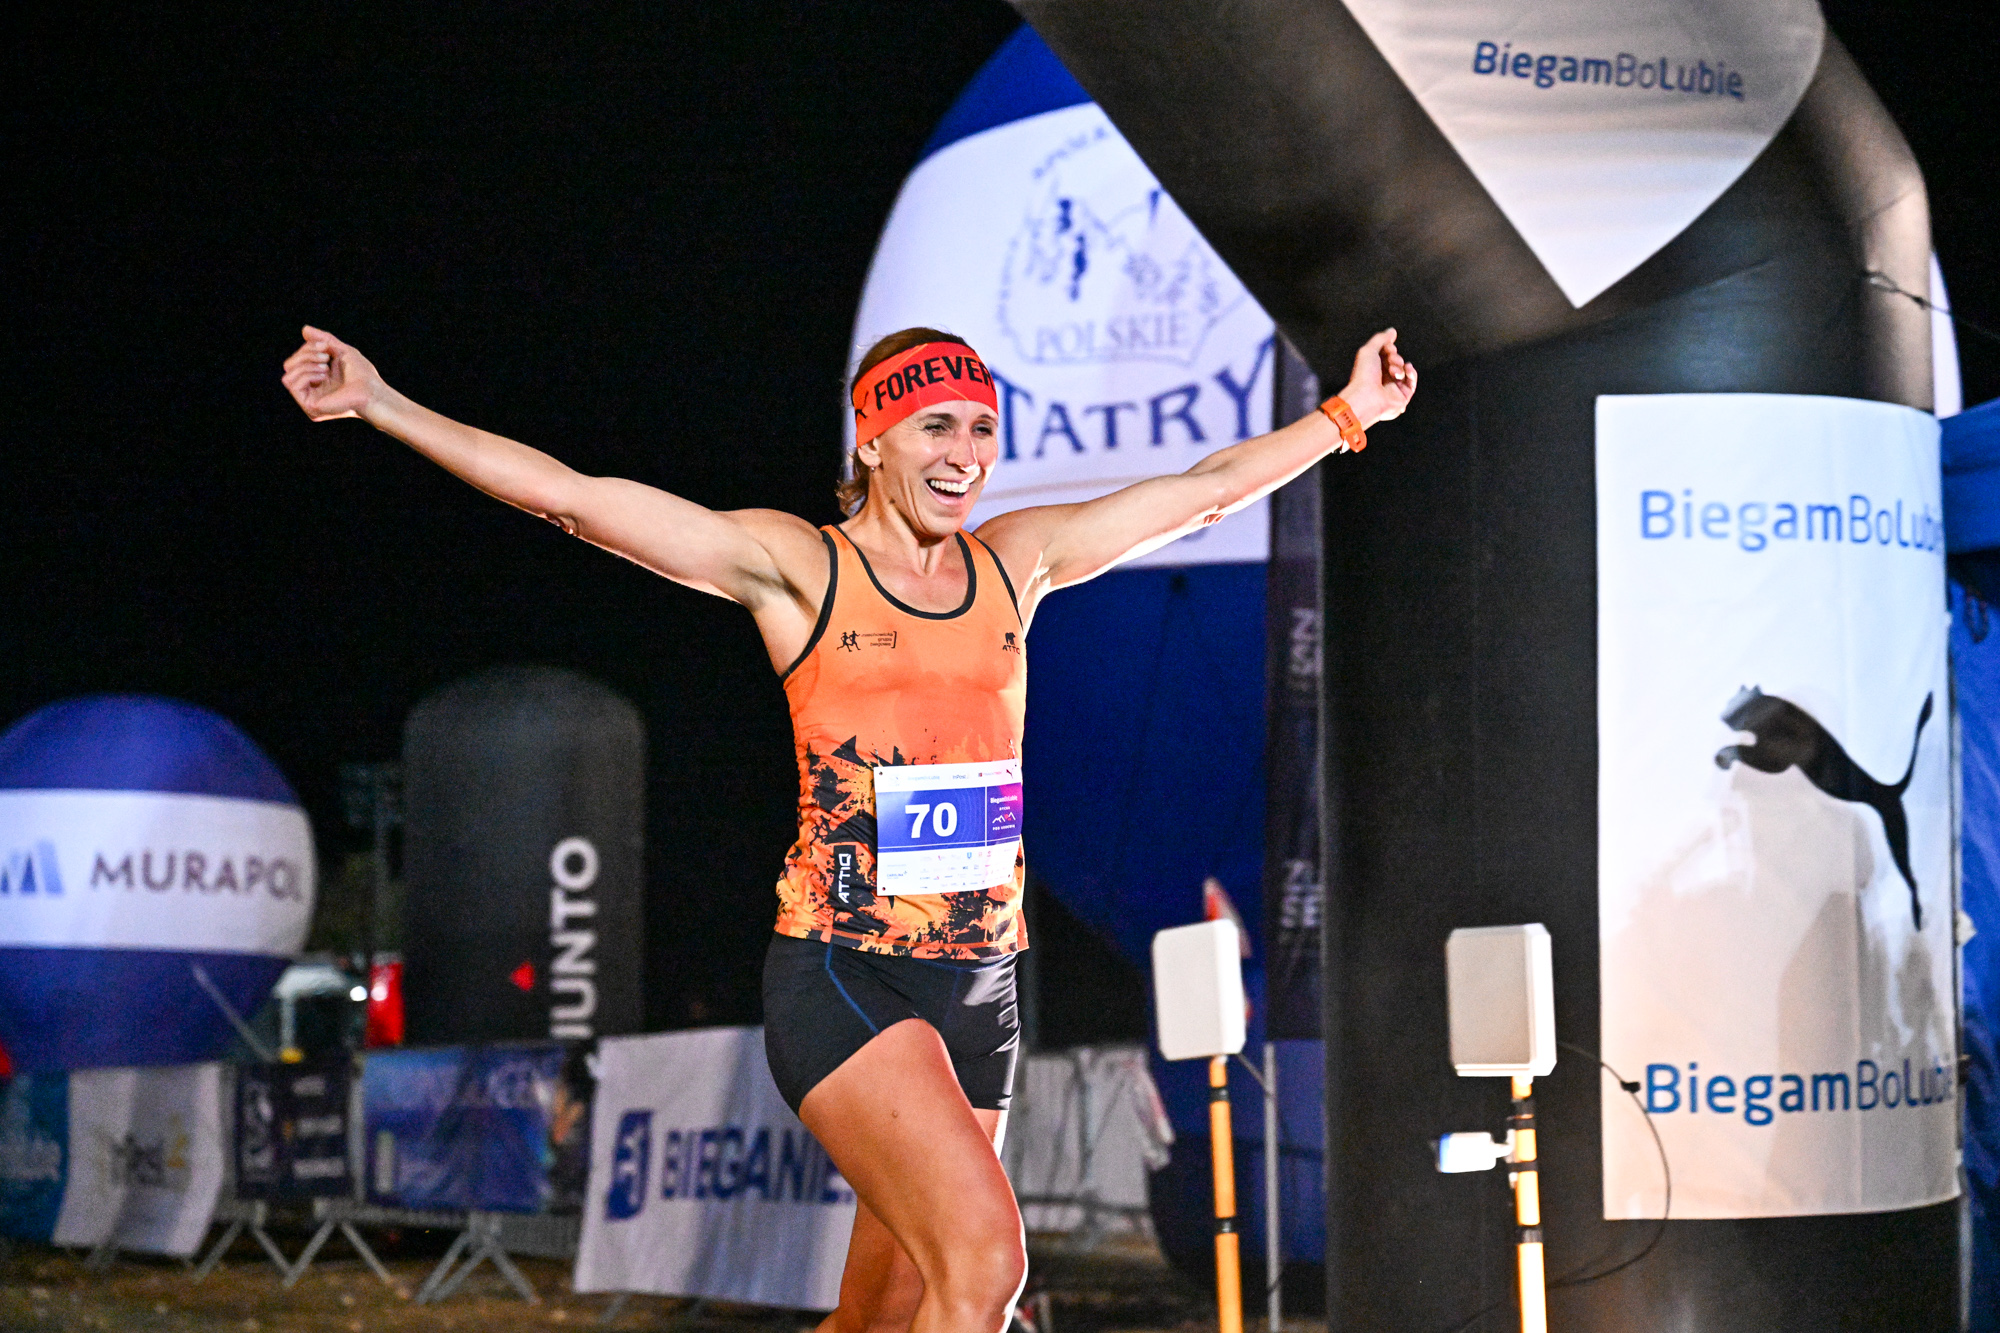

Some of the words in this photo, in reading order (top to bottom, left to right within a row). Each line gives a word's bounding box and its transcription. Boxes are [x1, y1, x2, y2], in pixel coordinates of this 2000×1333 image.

[1473, 41, 1746, 101] BiegamBoLubie
[1035, 308, 1188, 358] POLSKIE
[989, 334, 1275, 463] TATRY
[905, 802, 958, 839] 70
[838, 853, 852, 904] ATTIQ
